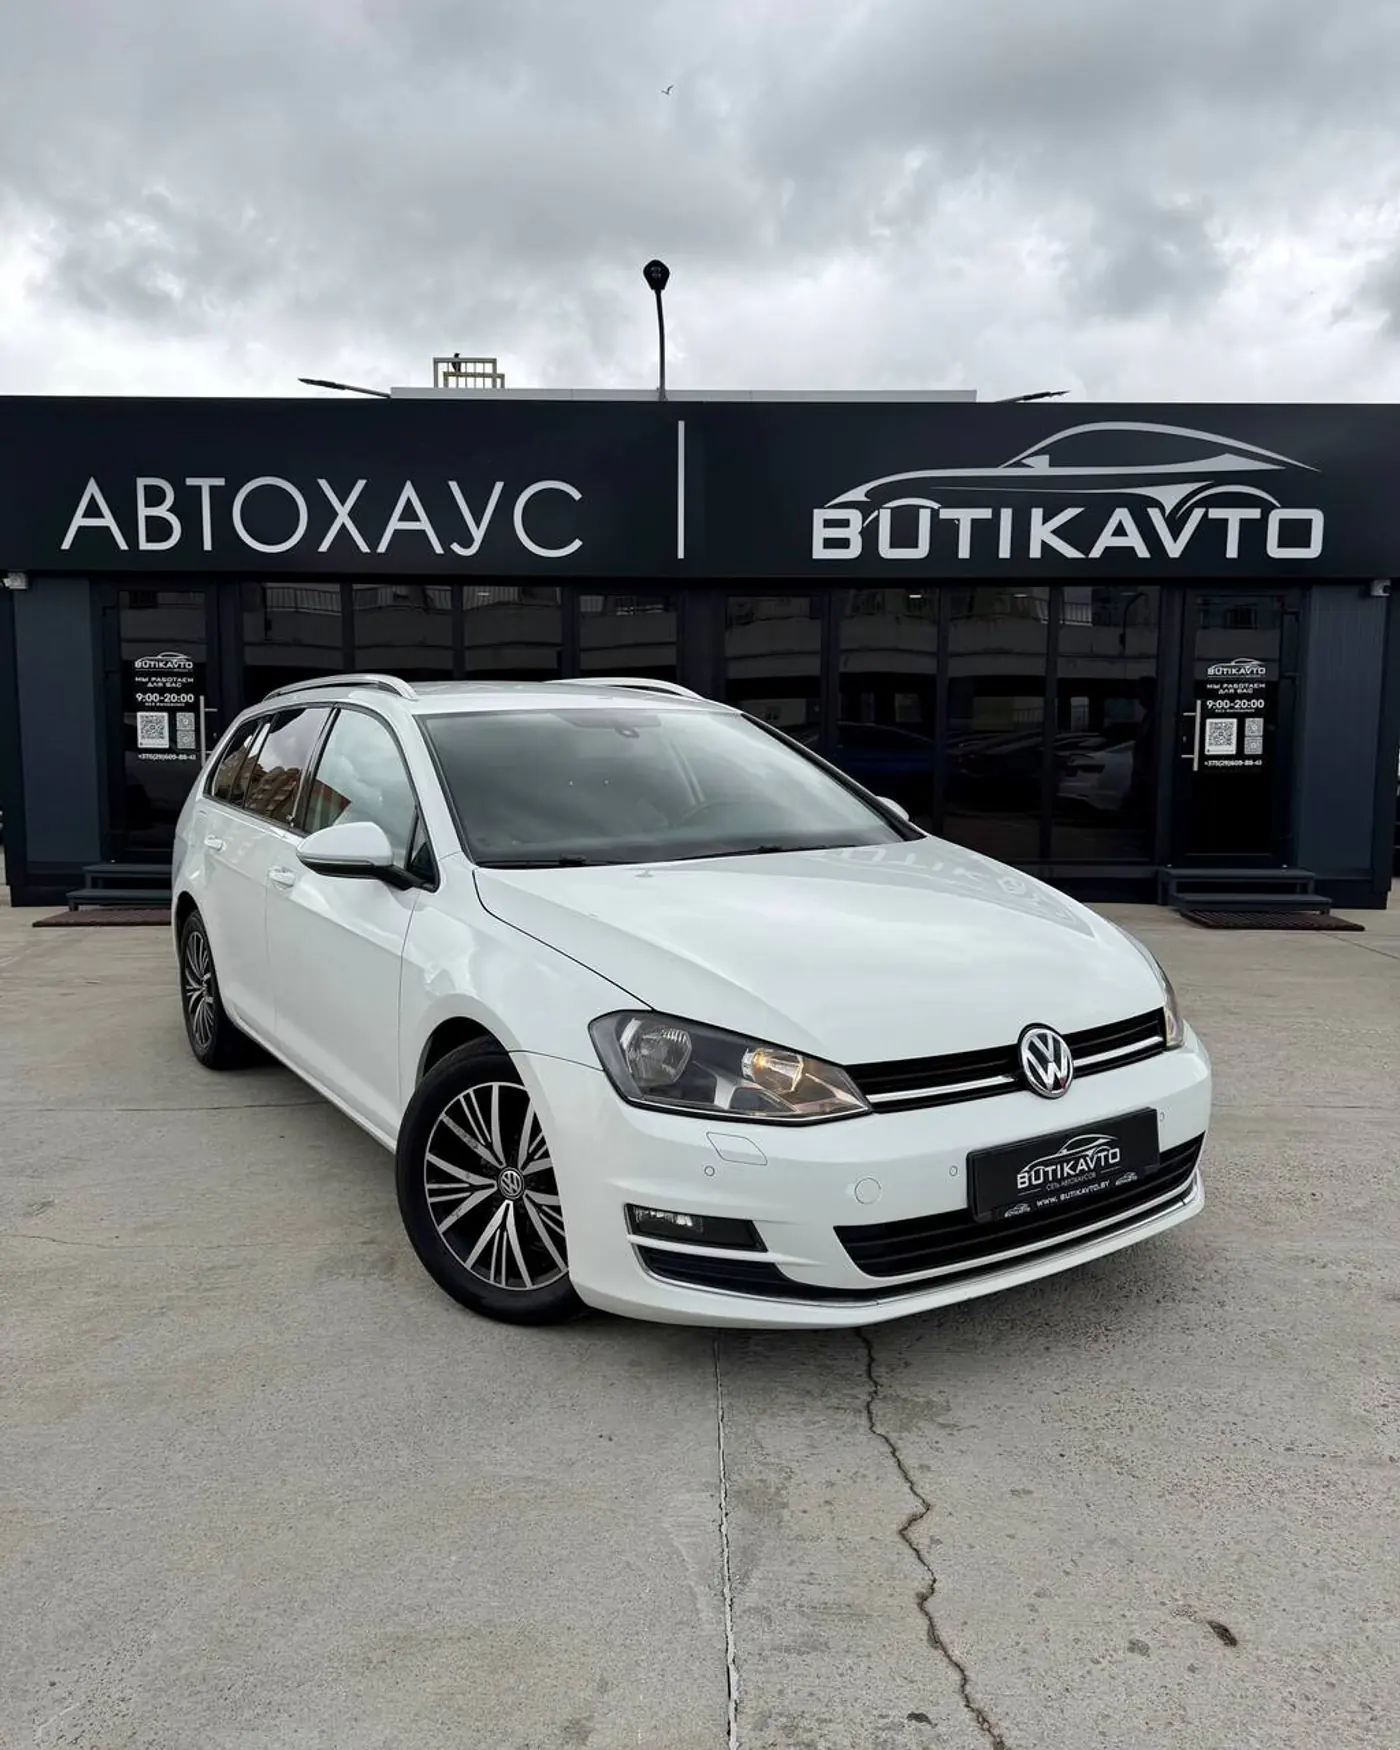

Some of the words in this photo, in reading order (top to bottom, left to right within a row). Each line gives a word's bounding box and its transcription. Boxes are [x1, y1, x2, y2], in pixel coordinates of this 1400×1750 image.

[61, 476, 583, 558] АВТОХАУС
[812, 507, 1324, 560] BUTIKAVTO
[135, 660, 194, 669] BUTIKAVTO
[1207, 667, 1266, 675] BUTIKAVTO
[135, 692, 195, 703] 9:00-20:00
[1206, 699, 1265, 709] 9:00-20:00
[1017, 1148, 1121, 1189] BUTIKAVTO
